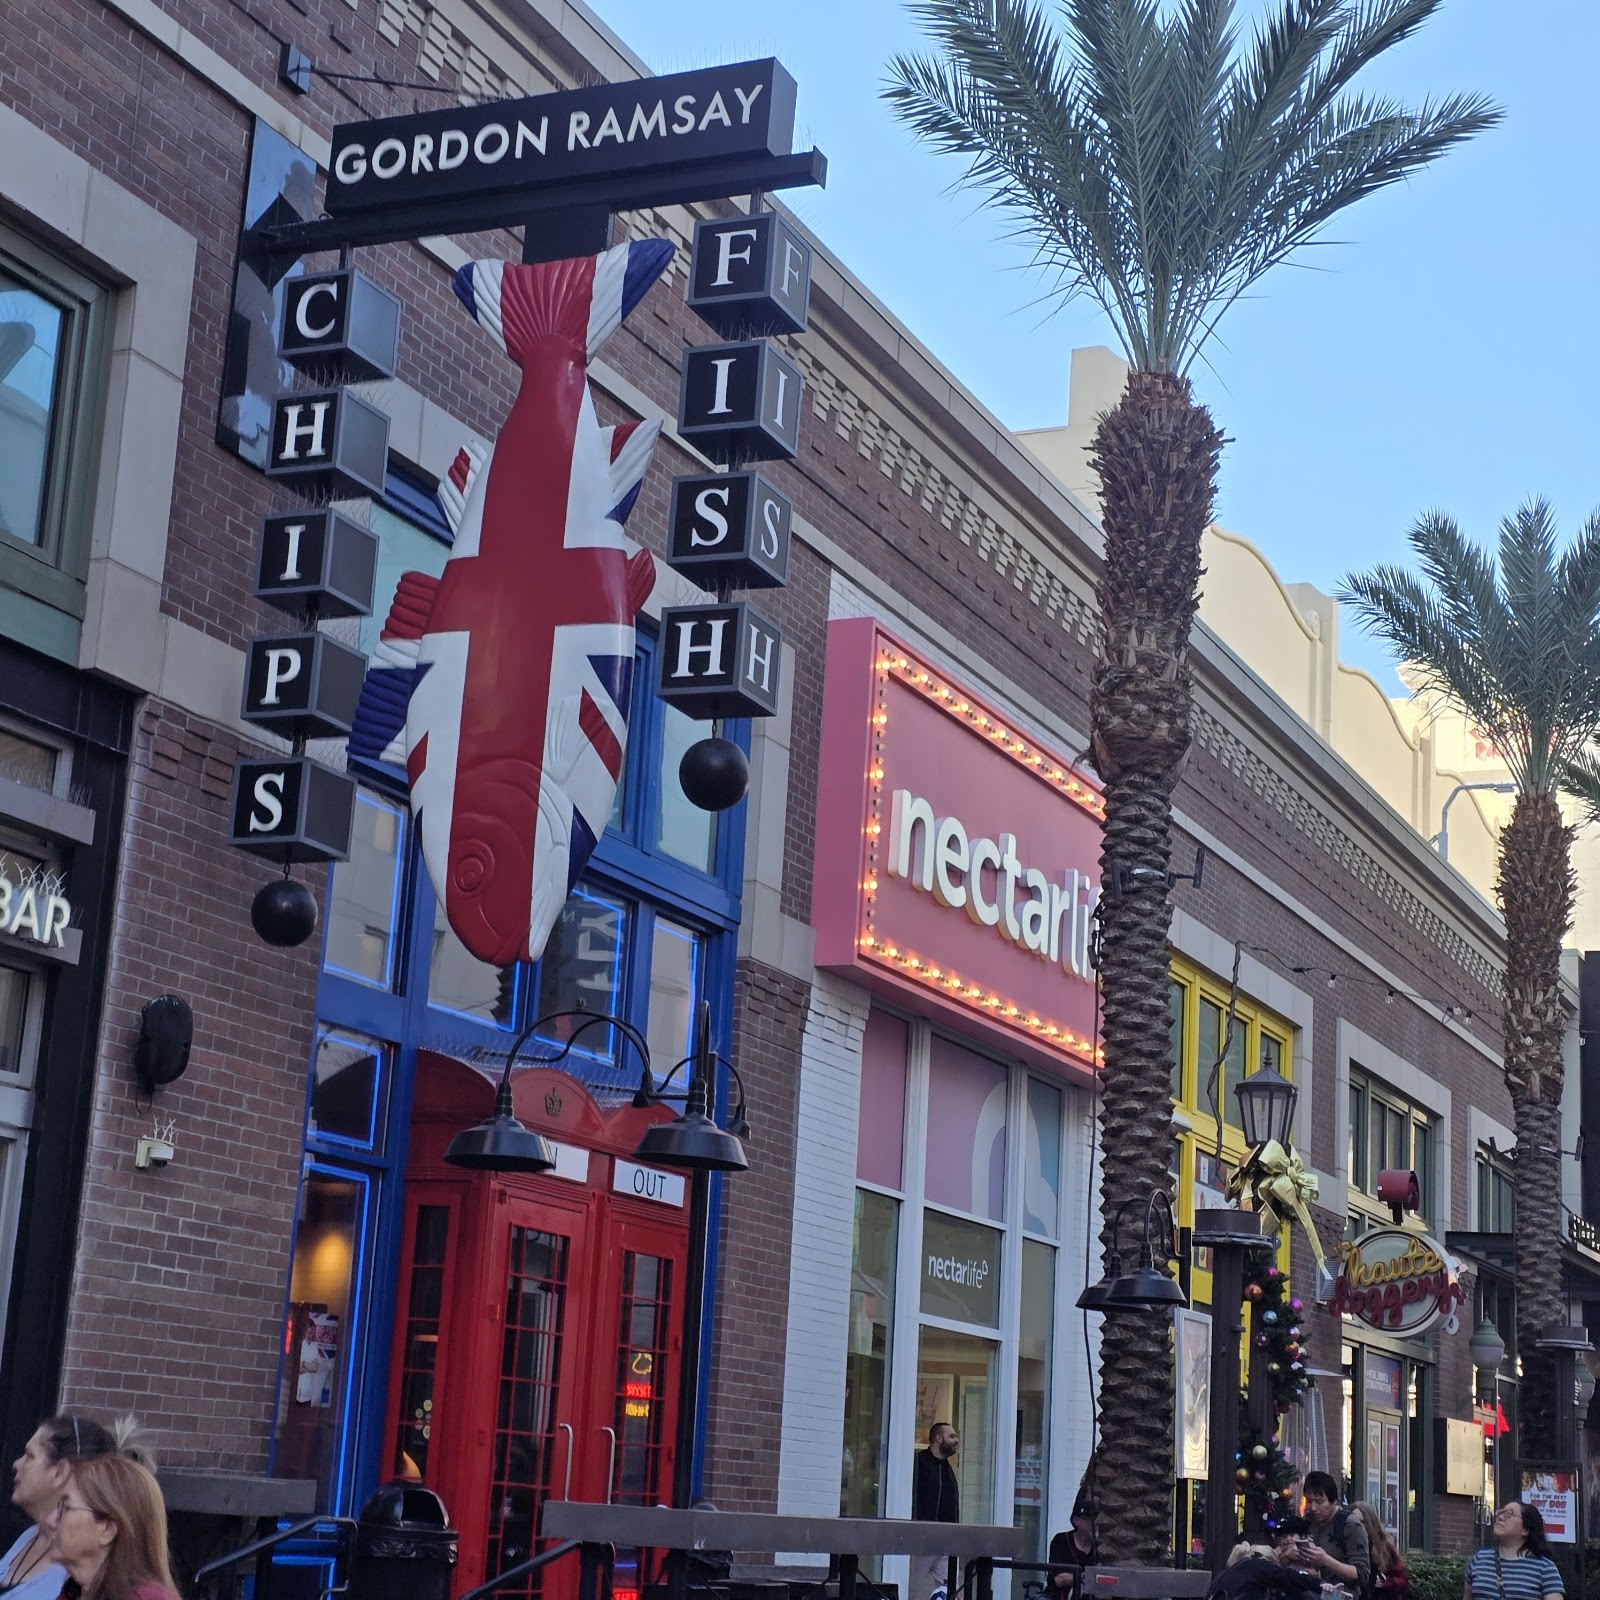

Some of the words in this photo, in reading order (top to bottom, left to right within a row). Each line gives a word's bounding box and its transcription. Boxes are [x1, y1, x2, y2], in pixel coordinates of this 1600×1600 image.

[335, 116, 549, 185] GORDON
[567, 84, 764, 151] RAMSAY
[671, 228, 757, 678] FISH
[748, 236, 803, 694] FISH
[248, 281, 338, 833] CHIPS
[0, 877, 71, 948] BAR
[888, 789, 1103, 983] nectarli
[633, 1168, 667, 1199] OUT
[928, 1255, 983, 1289] nectarlife
[1347, 1237, 1443, 1288] haute
[1549, 1500, 1567, 1509] DOG
